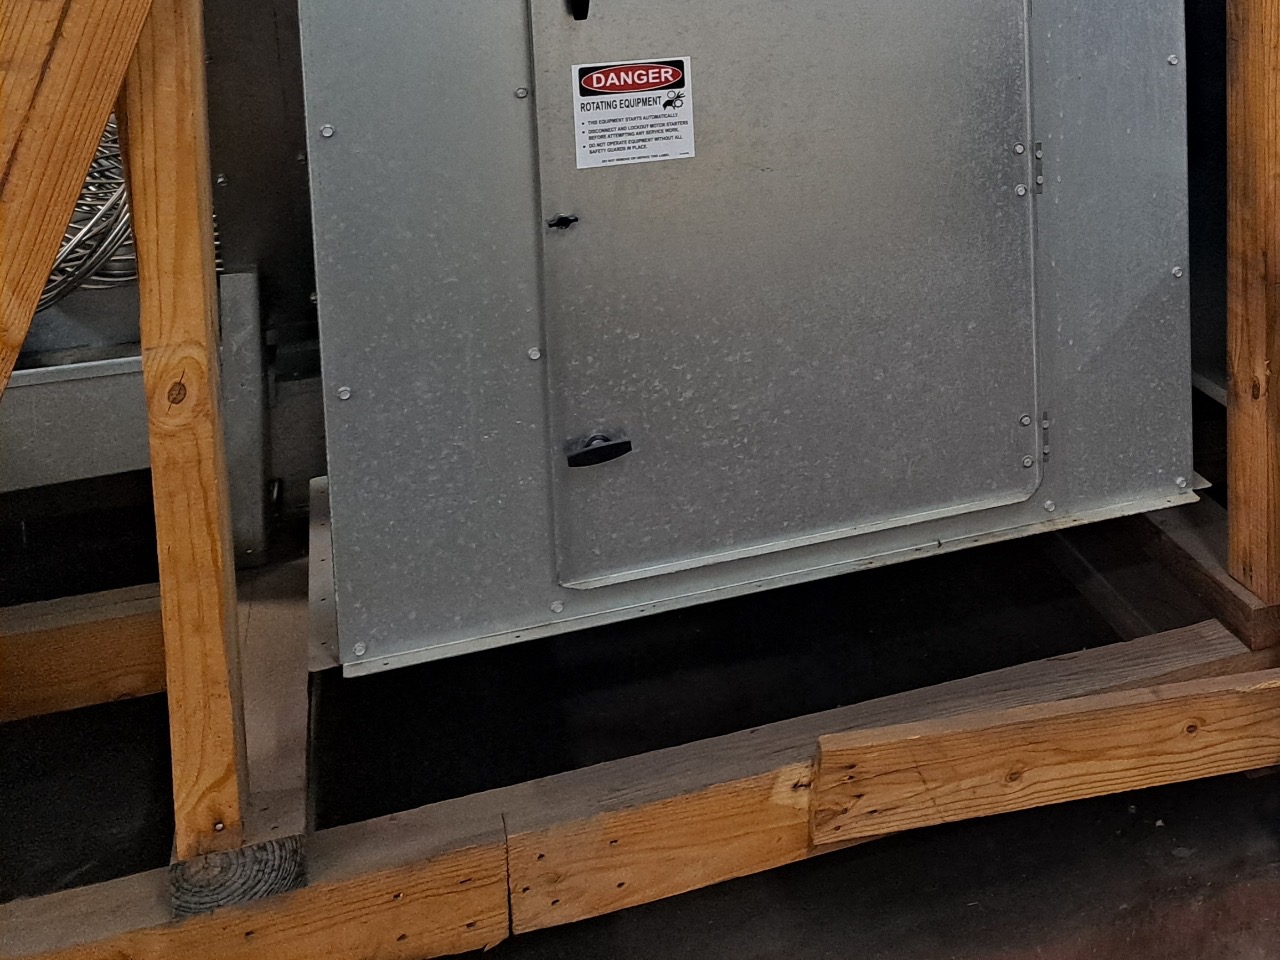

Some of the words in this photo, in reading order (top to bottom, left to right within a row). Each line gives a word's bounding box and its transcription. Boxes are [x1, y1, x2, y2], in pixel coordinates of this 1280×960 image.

[592, 68, 674, 88] DANGER
[580, 100, 618, 112] ROTATING
[620, 96, 662, 108] EQUIPMENT
[628, 137, 654, 145] EQUIPMENT
